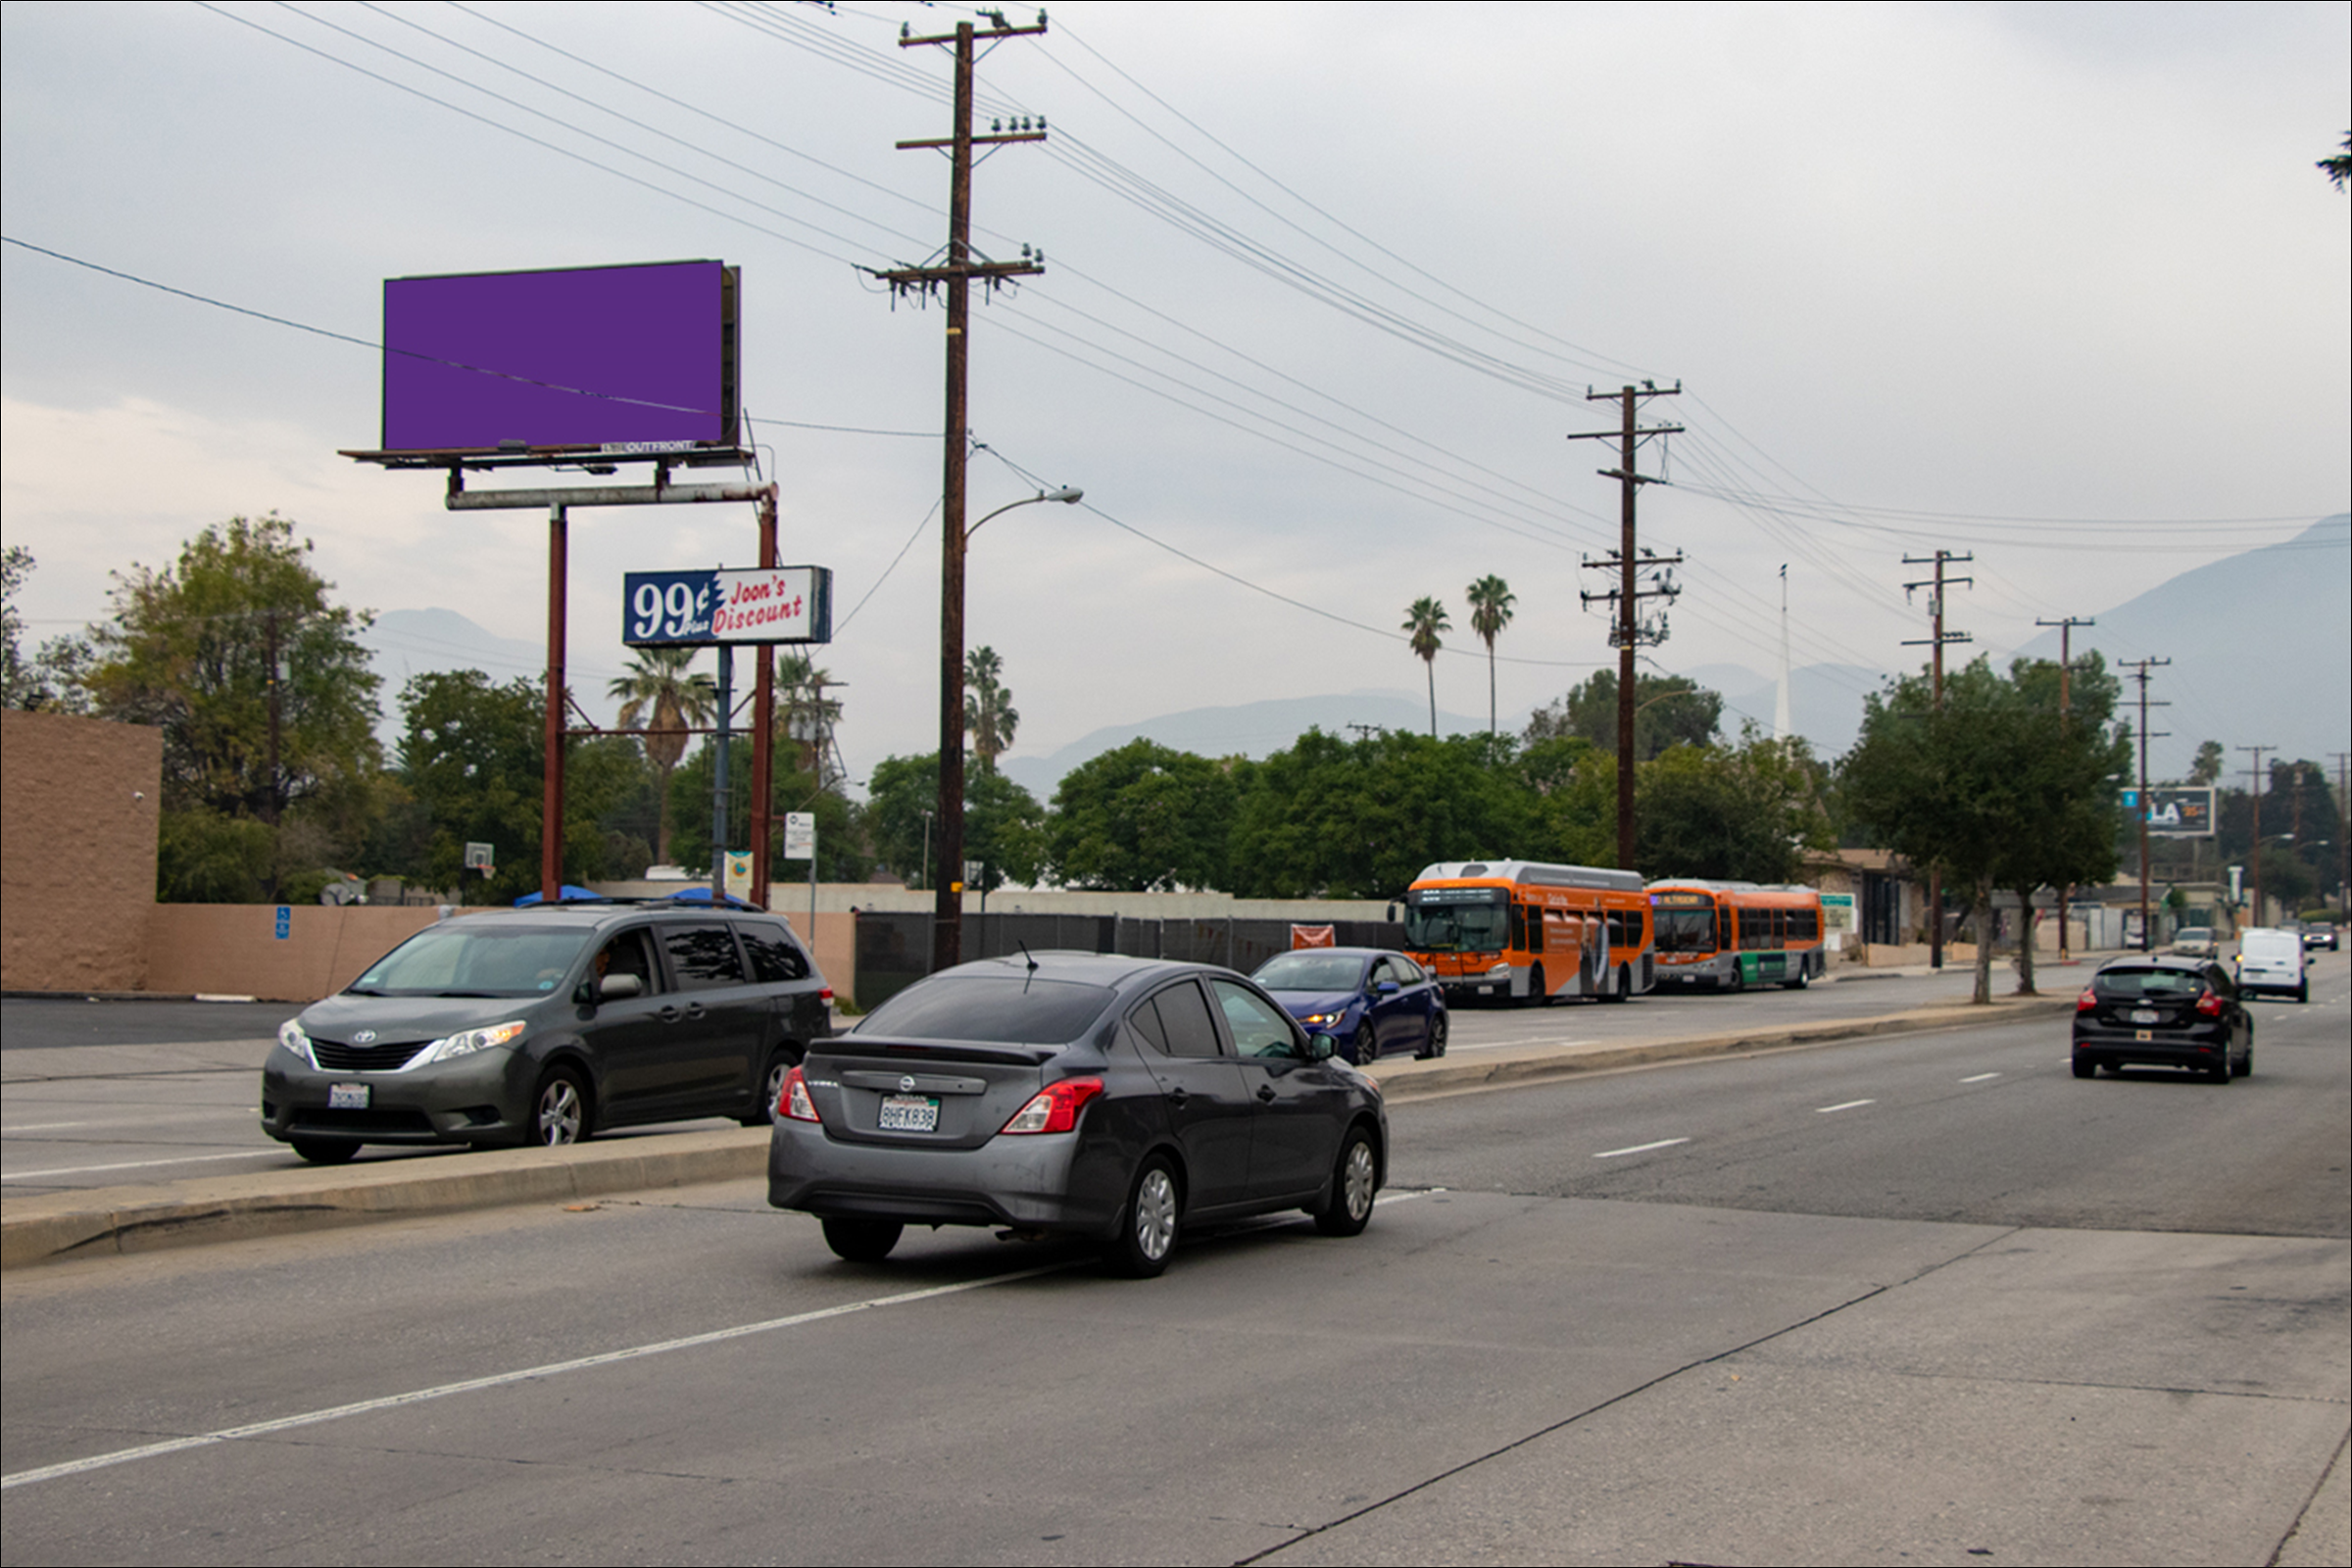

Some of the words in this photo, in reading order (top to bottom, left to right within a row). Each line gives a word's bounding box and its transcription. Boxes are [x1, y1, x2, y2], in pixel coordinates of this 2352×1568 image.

[626, 440, 693, 451] OUTFRONT
[729, 574, 786, 606] Joon's
[712, 595, 802, 634] Discount
